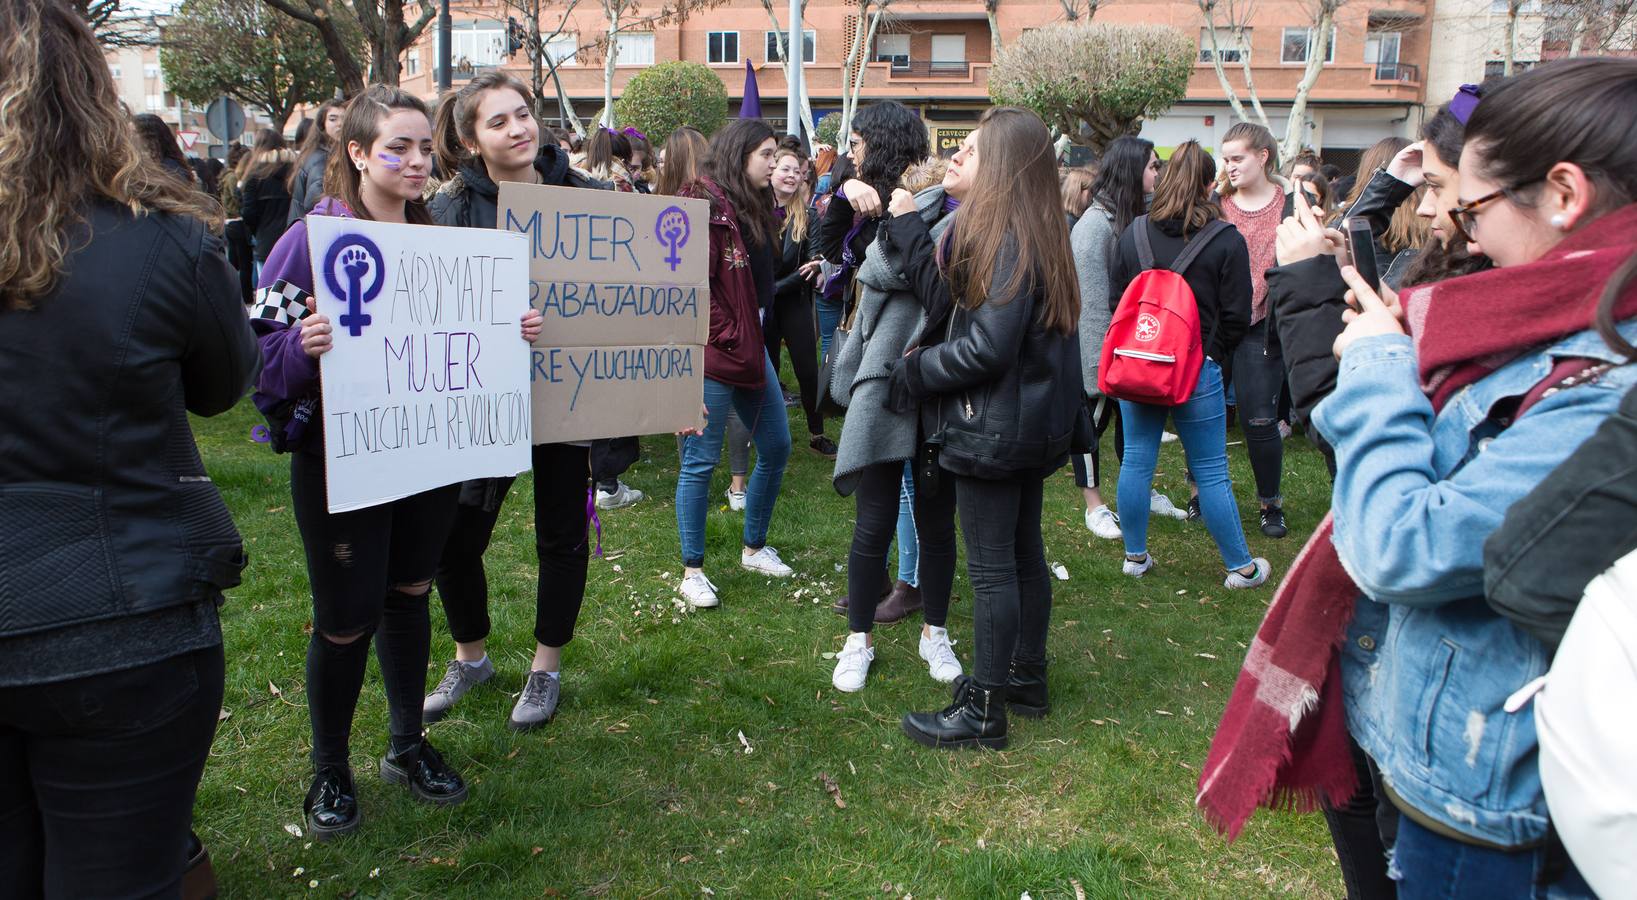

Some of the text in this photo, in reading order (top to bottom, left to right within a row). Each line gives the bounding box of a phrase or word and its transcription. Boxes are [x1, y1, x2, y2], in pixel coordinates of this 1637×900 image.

[506, 208, 640, 271] MUJER
[391, 250, 513, 326] Á(R)MATE
[529, 280, 698, 318] RABAJADORA
[385, 332, 483, 394] MUJER
[530, 349, 564, 383] RE
[594, 348, 693, 381] LUCHADORA
[331, 388, 530, 459] INICIA LA REVOLUCIÓN
